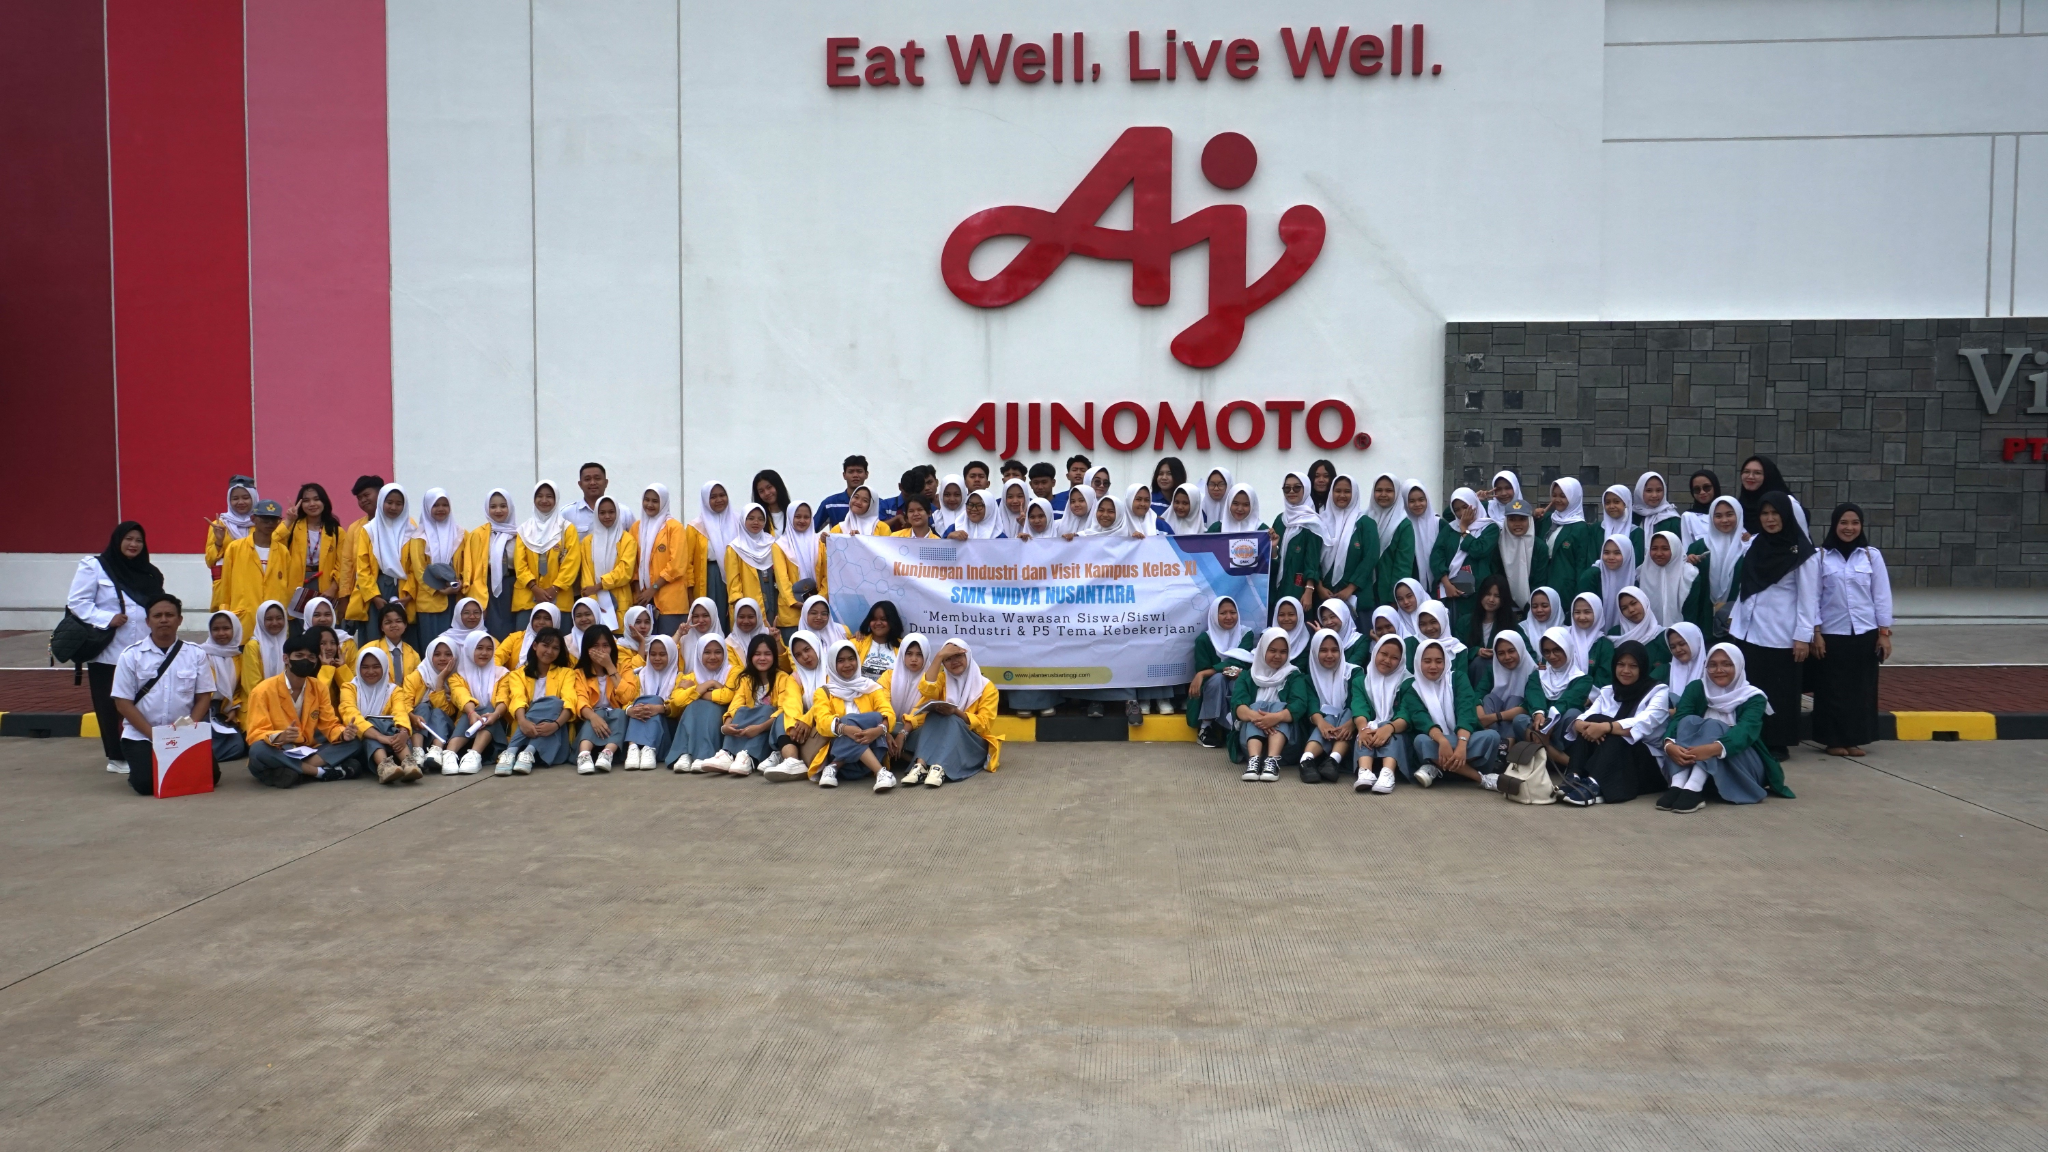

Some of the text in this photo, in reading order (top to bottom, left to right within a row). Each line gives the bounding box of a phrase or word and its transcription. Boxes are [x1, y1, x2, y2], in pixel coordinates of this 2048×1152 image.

[826, 23, 1443, 87] Eat Well, Live Well.
[1958, 347, 2048, 415] Vi
[893, 560, 1197, 580] Kunjungan Industri dan Visit Kampus Kelas XI
[950, 584, 1136, 605] SMK WIDYA NUSANTARA
[923, 610, 1166, 624] "Membuka Wawasan Siswa/Siswi
[909, 622, 1202, 637] Dunia Industri & P5 Tema Kebekerjaan"
